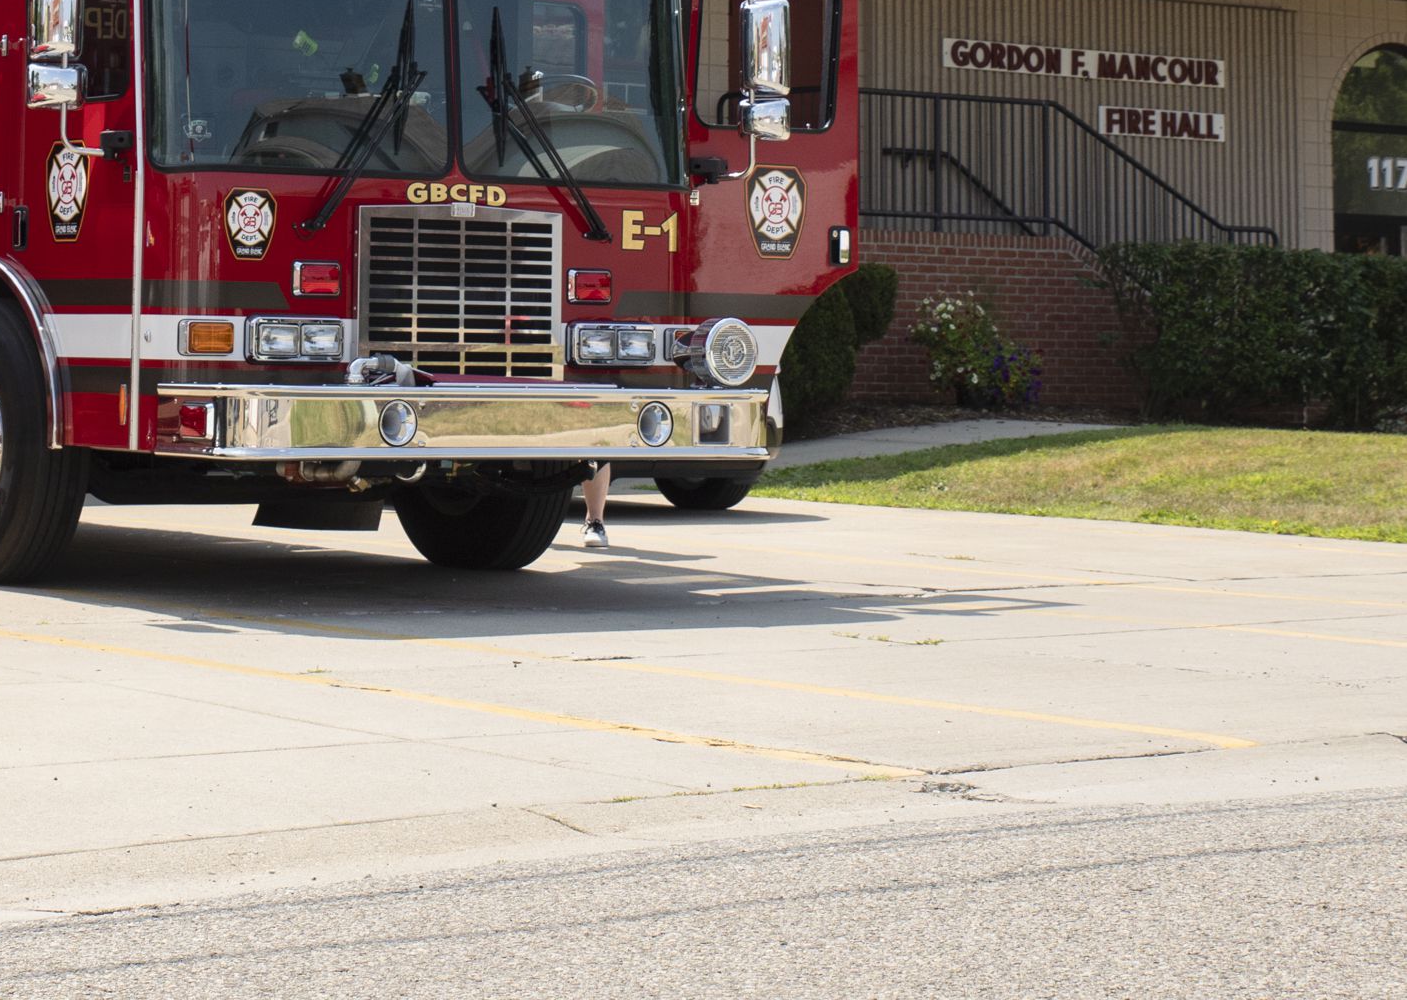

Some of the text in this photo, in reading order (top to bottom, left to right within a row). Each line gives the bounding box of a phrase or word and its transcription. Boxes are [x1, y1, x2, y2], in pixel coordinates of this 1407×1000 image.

[950, 40, 1061, 74] GORDON
[1097, 53, 1219, 86] MANCOUR
[1105, 108, 1220, 140] FIRE HALL
[62, 152, 74, 161] FIRE
[768, 176, 784, 185] FIRE
[1367, 157, 1407, 190] 117
[244, 196, 258, 204] FIRE
[406, 182, 507, 206] GBCFD
[622, 210, 678, 252] E-1
